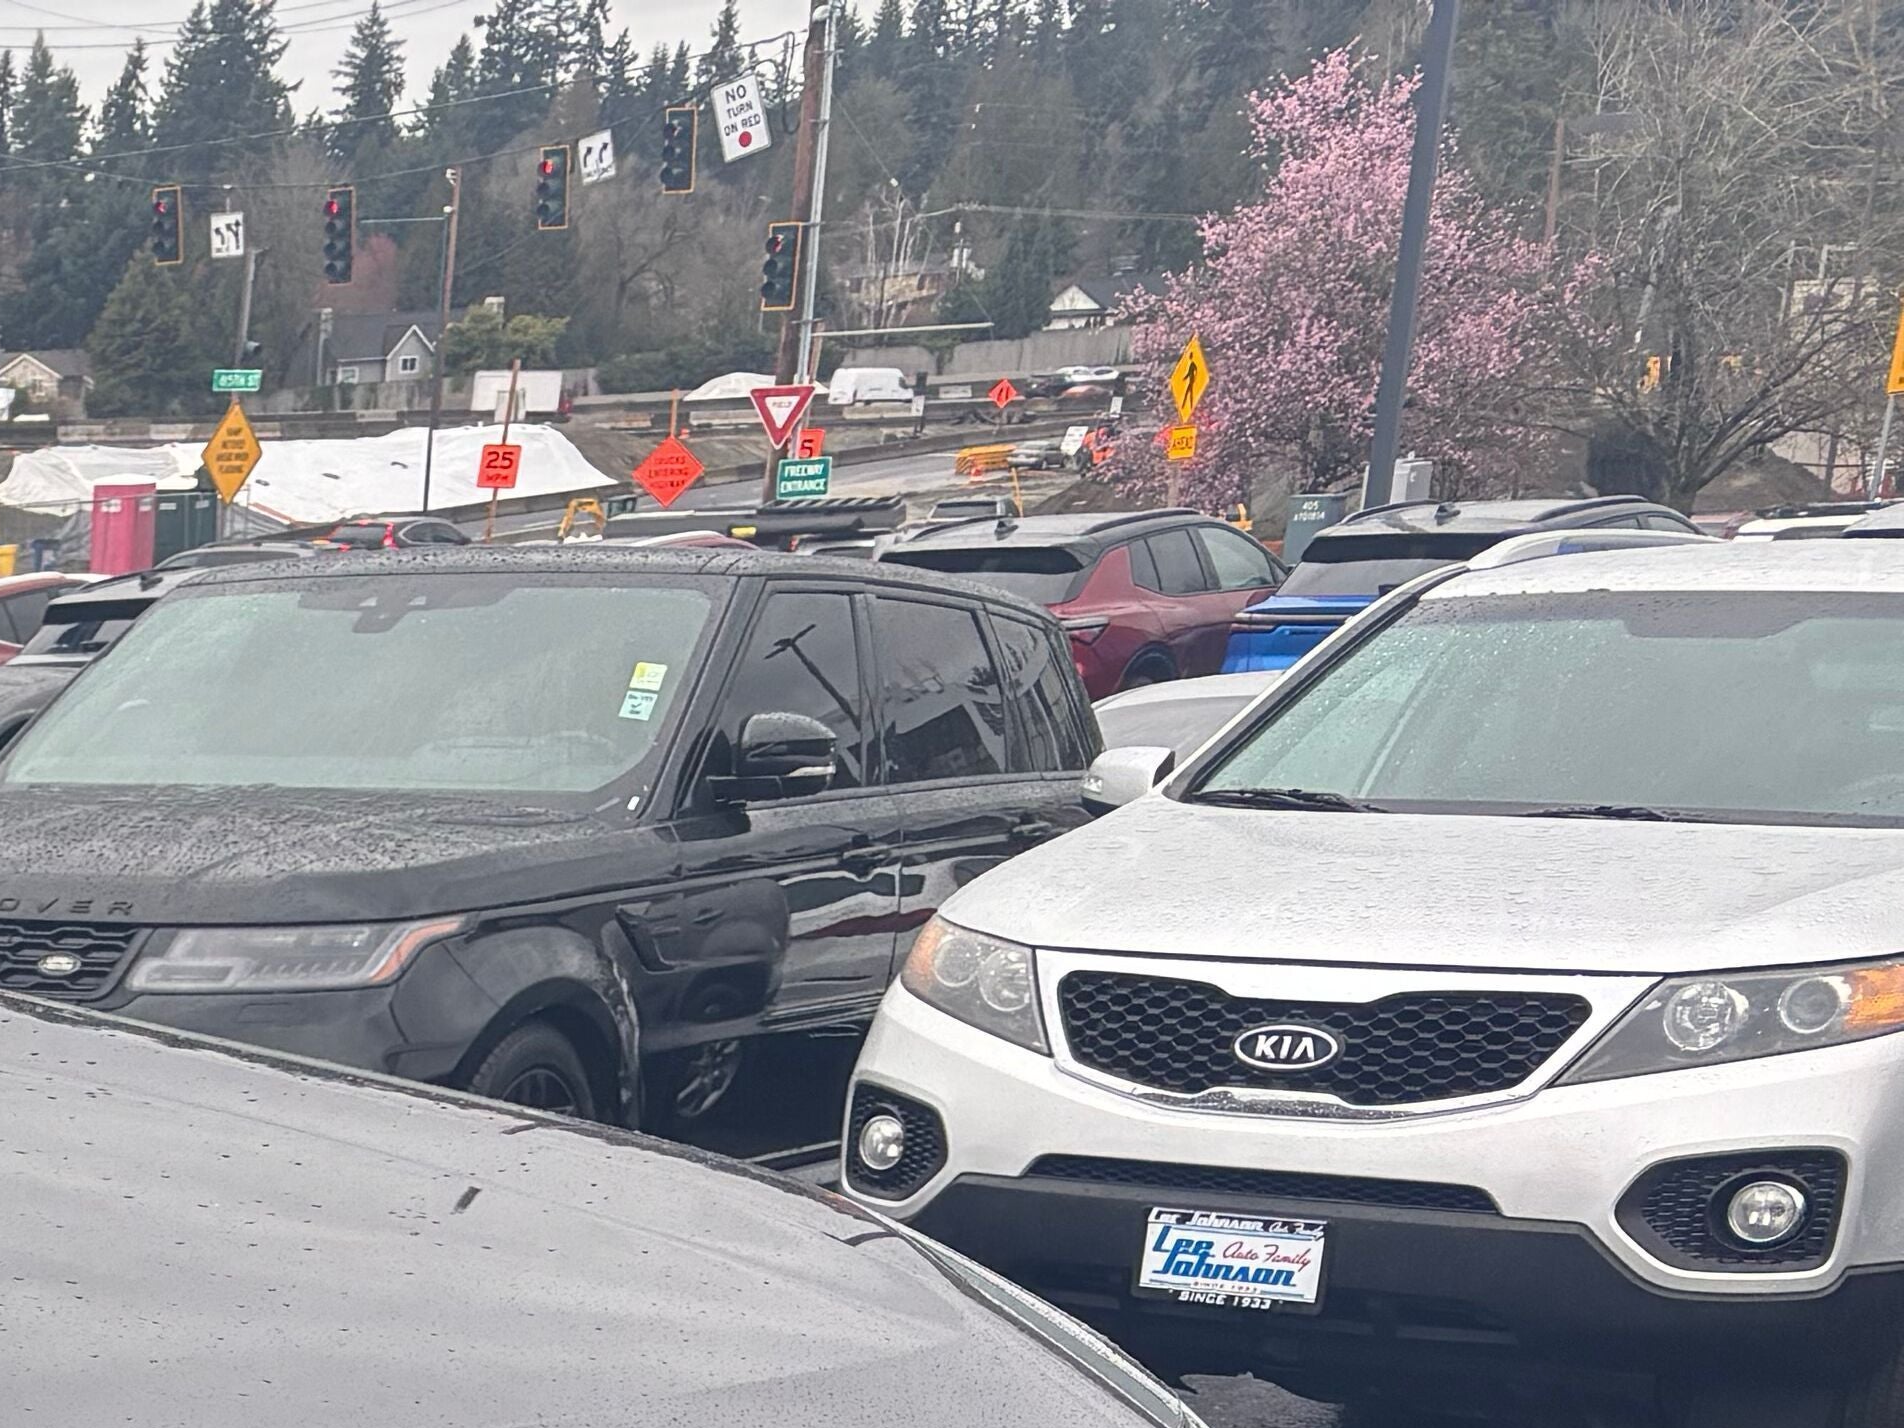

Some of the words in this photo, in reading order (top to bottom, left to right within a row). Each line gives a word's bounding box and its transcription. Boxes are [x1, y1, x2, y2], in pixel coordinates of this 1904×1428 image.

[725, 84, 747, 104] NO
[726, 100, 753, 119] TURN
[724, 122, 738, 137] ON
[741, 113, 761, 129] RED
[798, 438, 814, 458] 5
[486, 451, 514, 469] 25
[784, 464, 825, 477] FREEWAY
[780, 479, 827, 493] ENTRANCE
[1254, 1034, 1315, 1061] KIA
[1152, 1226, 1215, 1257] Lee
[1223, 1241, 1259, 1261] Auto
[1263, 1244, 1311, 1273] Family
[1152, 1251, 1296, 1287] Johnson
[1178, 1291, 1227, 1306] SINCE
[1233, 1296, 1271, 1310] 1933
